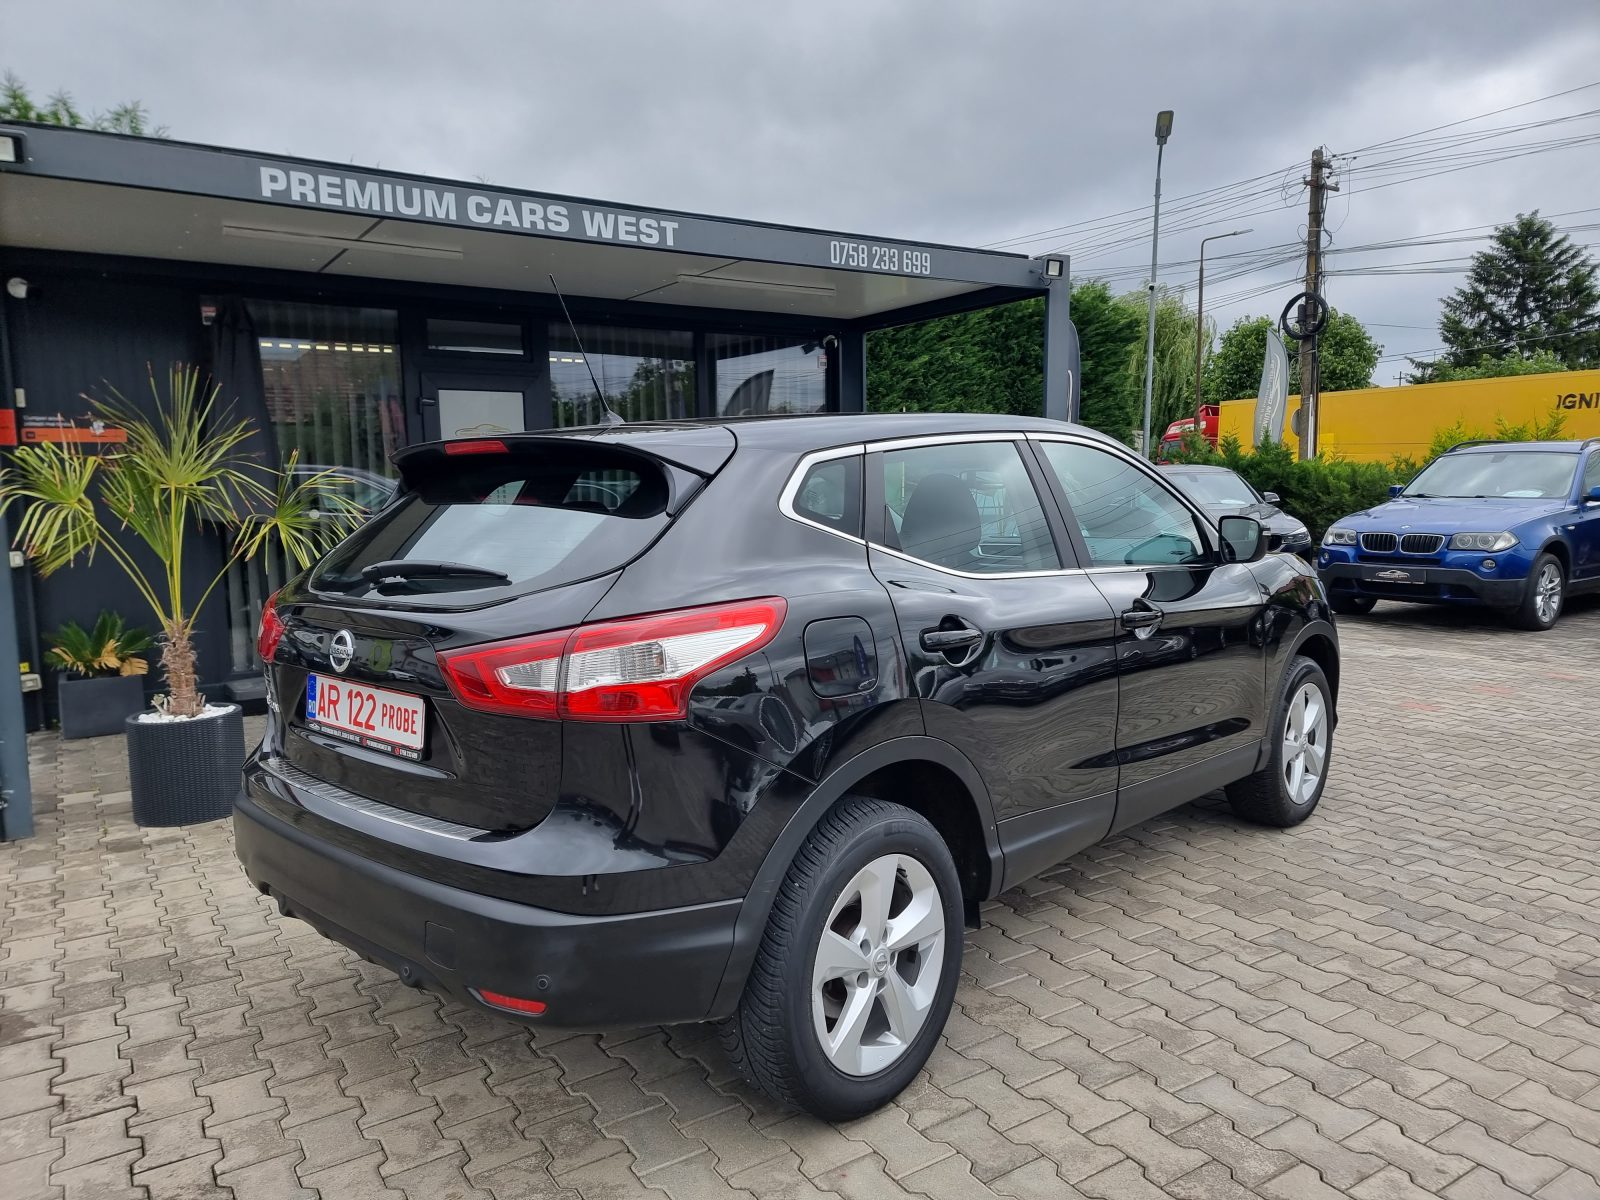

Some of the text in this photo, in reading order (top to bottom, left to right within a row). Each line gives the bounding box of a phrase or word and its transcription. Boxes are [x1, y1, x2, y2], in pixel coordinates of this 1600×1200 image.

[259, 166, 679, 246] PREMIUM CARS WEST
[830, 241, 930, 275] 0758 233 699
[317, 682, 340, 721] AR
[347, 688, 377, 732] 122
[381, 703, 418, 735] PROBE
